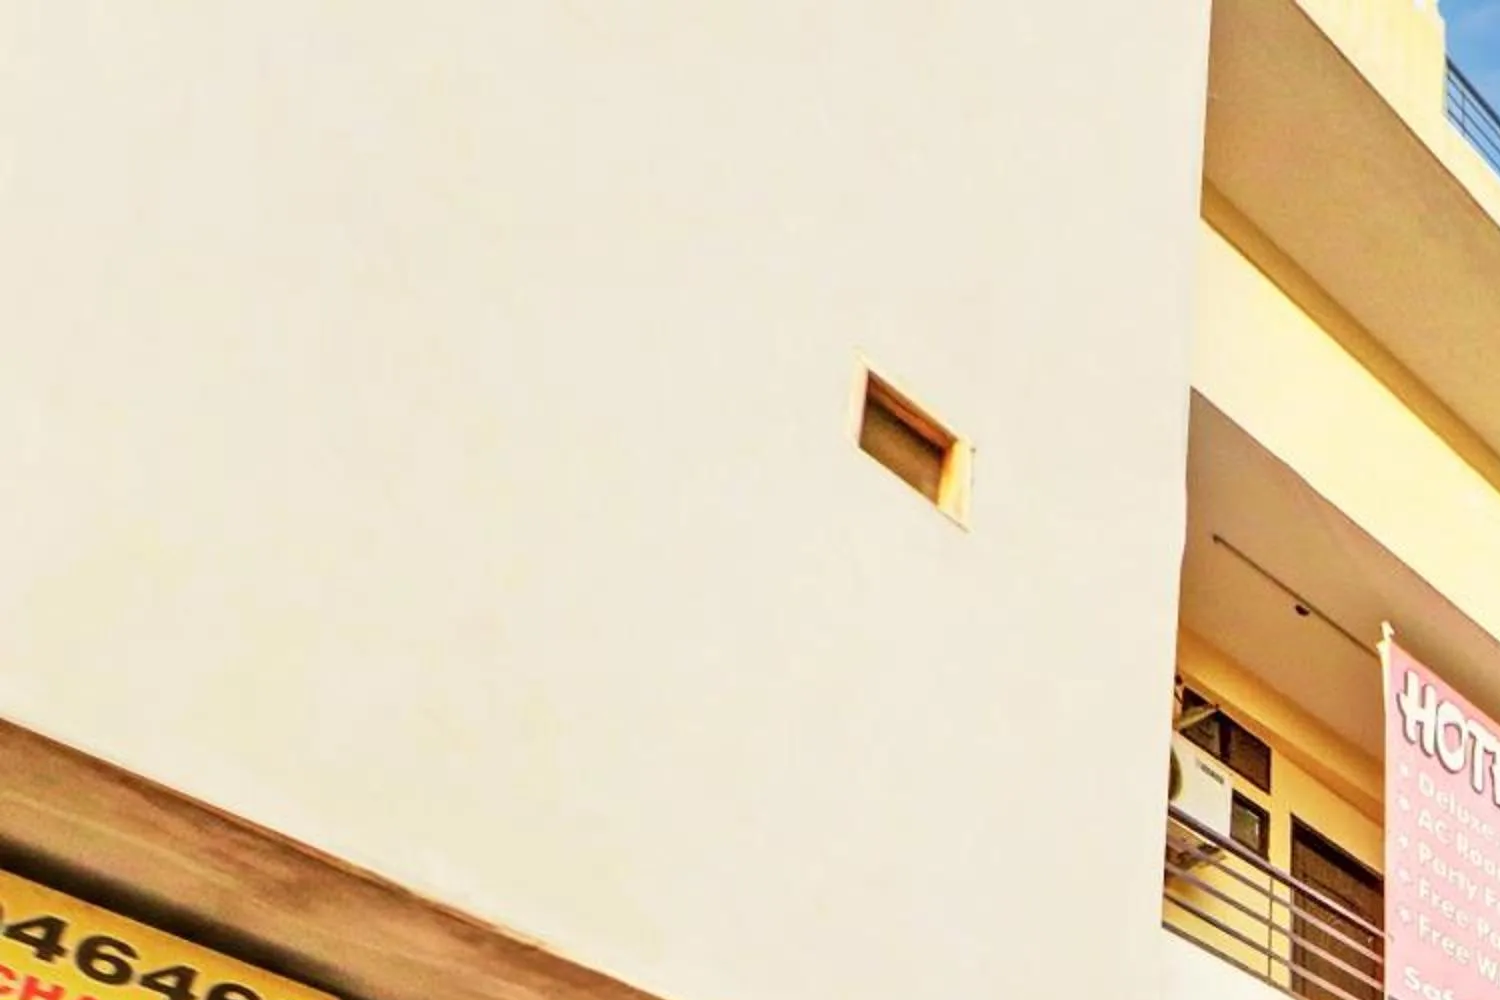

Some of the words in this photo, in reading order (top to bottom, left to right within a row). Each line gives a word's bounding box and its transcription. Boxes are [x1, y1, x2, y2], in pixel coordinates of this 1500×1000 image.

[1418, 808, 1452, 845] AC
[1418, 841, 1478, 900] Party
[1418, 877, 1470, 929] Free
[1418, 914, 1471, 965] Free
